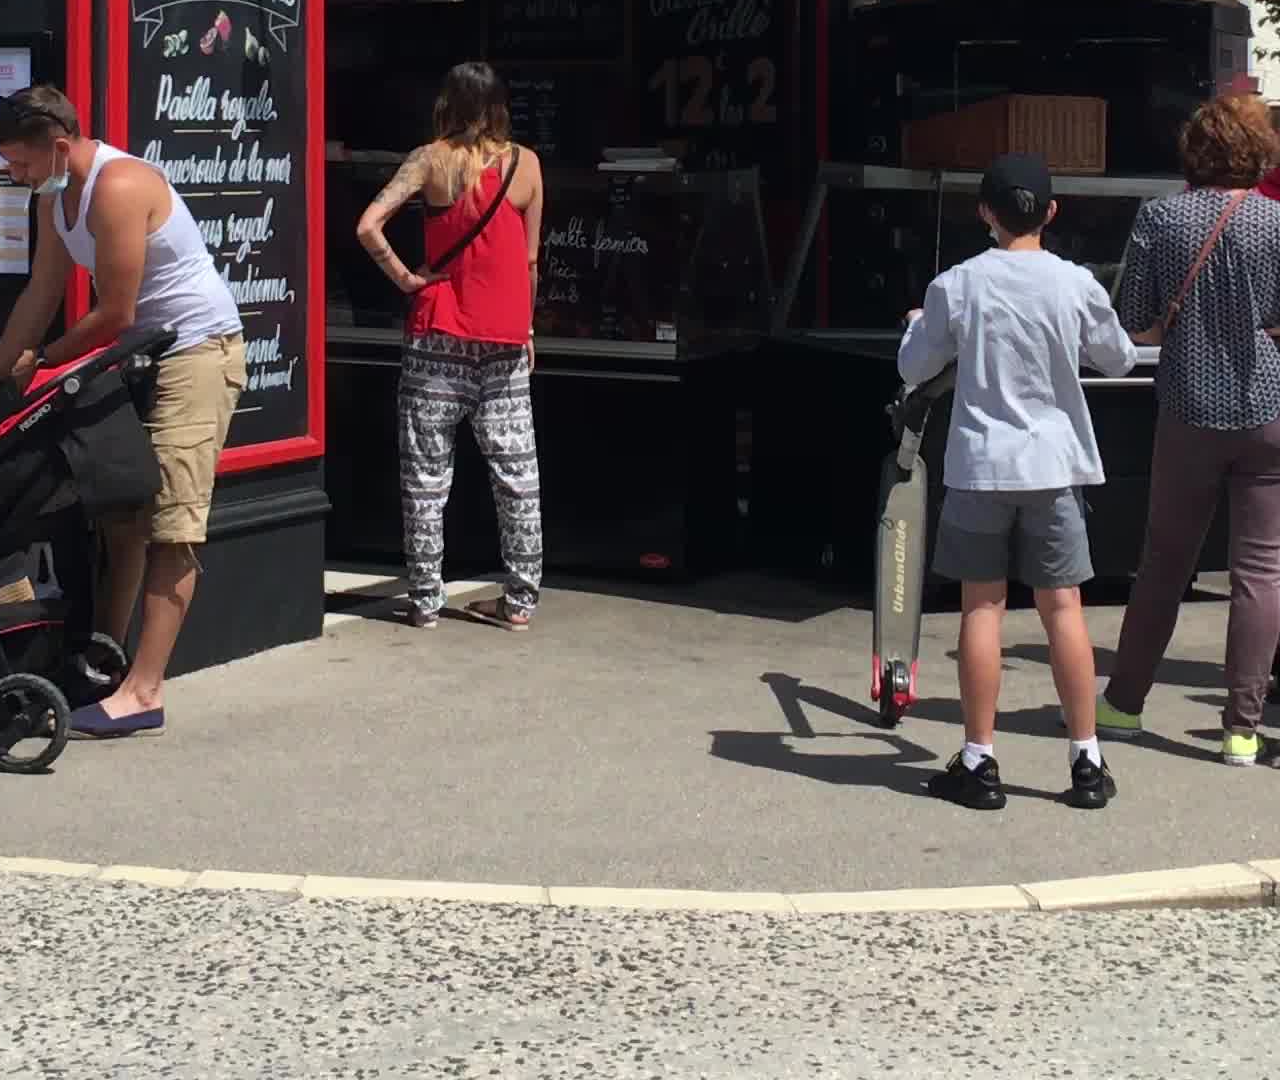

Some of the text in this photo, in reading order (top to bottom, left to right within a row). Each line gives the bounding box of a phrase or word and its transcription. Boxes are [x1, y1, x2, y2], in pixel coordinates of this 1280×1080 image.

[220, 79, 278, 140] royale
[228, 142, 246, 183] de
[246, 139, 263, 183] la
